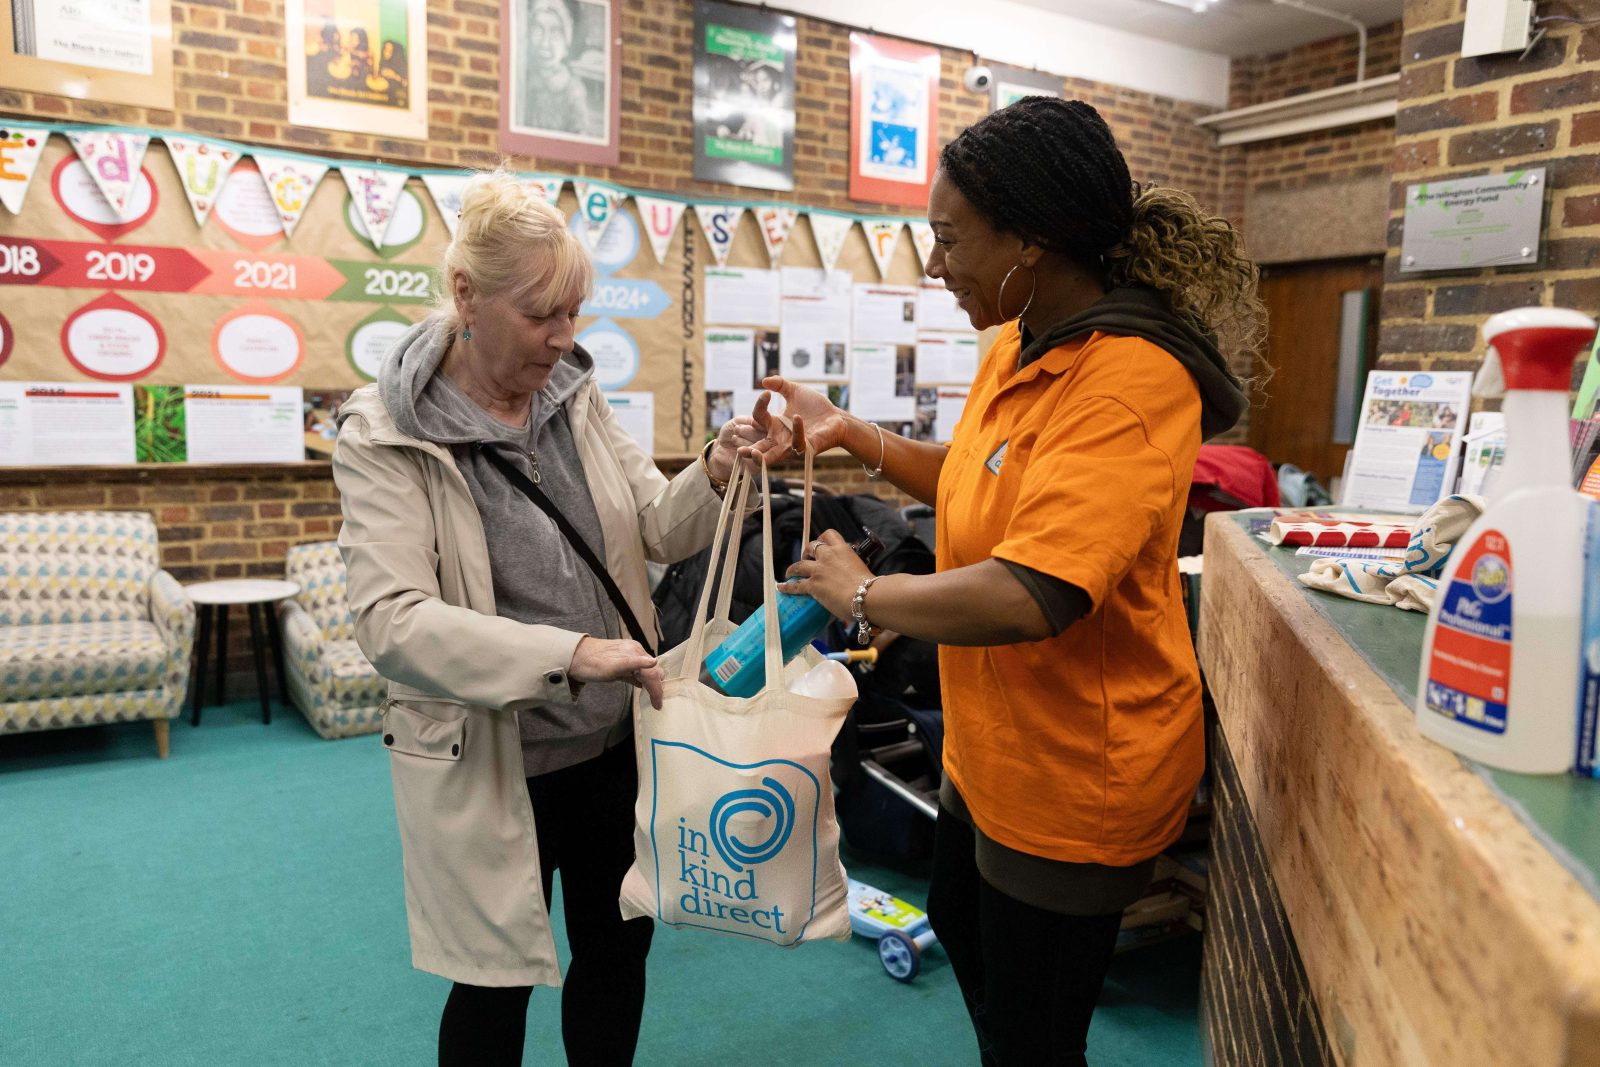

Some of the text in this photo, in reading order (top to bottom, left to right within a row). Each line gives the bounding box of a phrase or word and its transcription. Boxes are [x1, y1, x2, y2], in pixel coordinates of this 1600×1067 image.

[1436, 187, 1473, 199] Islington
[1475, 182, 1528, 195] Community
[1444, 194, 1499, 207] Energy Fund
[85, 250, 156, 282] 2019
[233, 259, 297, 291] 2021
[364, 267, 430, 298] 2022
[591, 284, 650, 310] 2024+
[1373, 386, 1421, 397] Together
[678, 816, 709, 858] in
[678, 850, 759, 900] kind
[680, 887, 787, 934] direct
